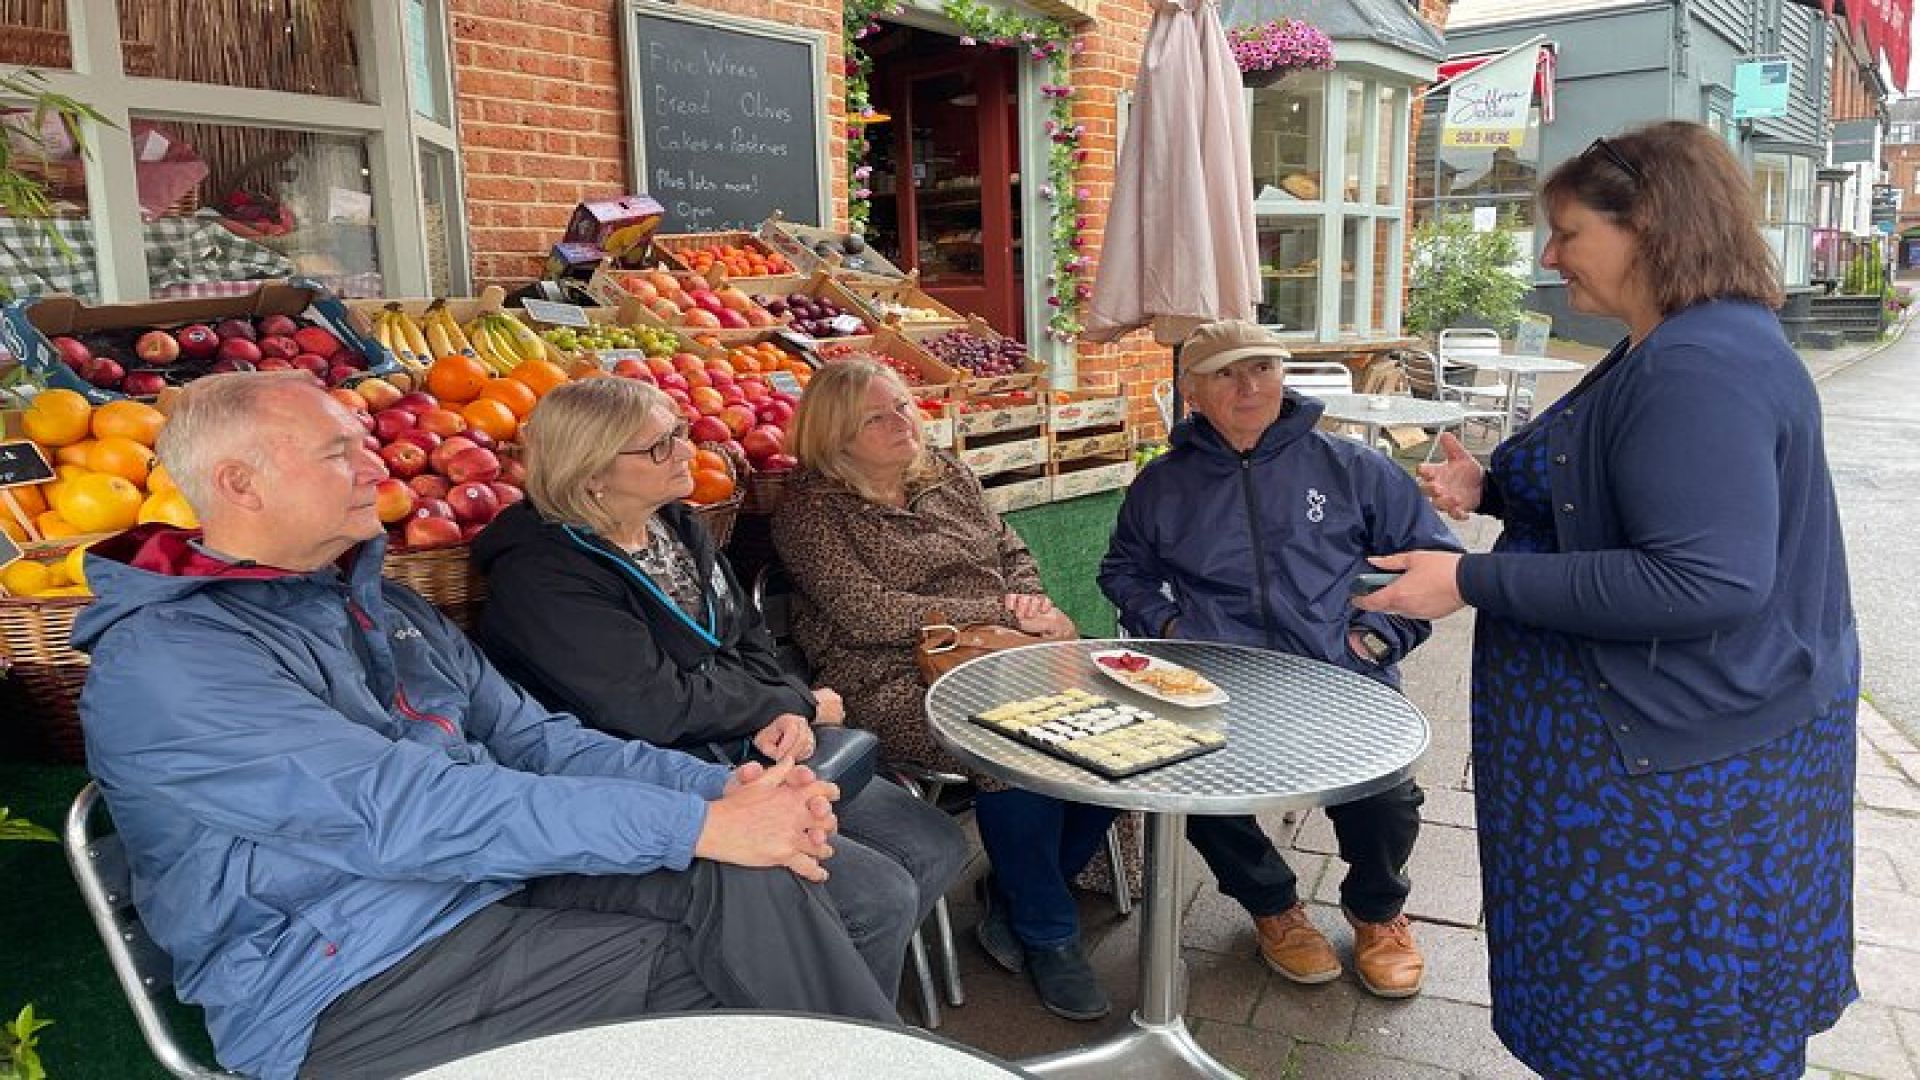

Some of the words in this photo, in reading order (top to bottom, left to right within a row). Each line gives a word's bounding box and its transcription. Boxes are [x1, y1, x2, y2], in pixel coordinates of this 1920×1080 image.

[655, 84, 711, 116] Bread
[741, 91, 793, 123] Olives
[1455, 131, 1481, 144] SOLD
[1484, 131, 1509, 144] HERE
[656, 168, 686, 190] Plus
